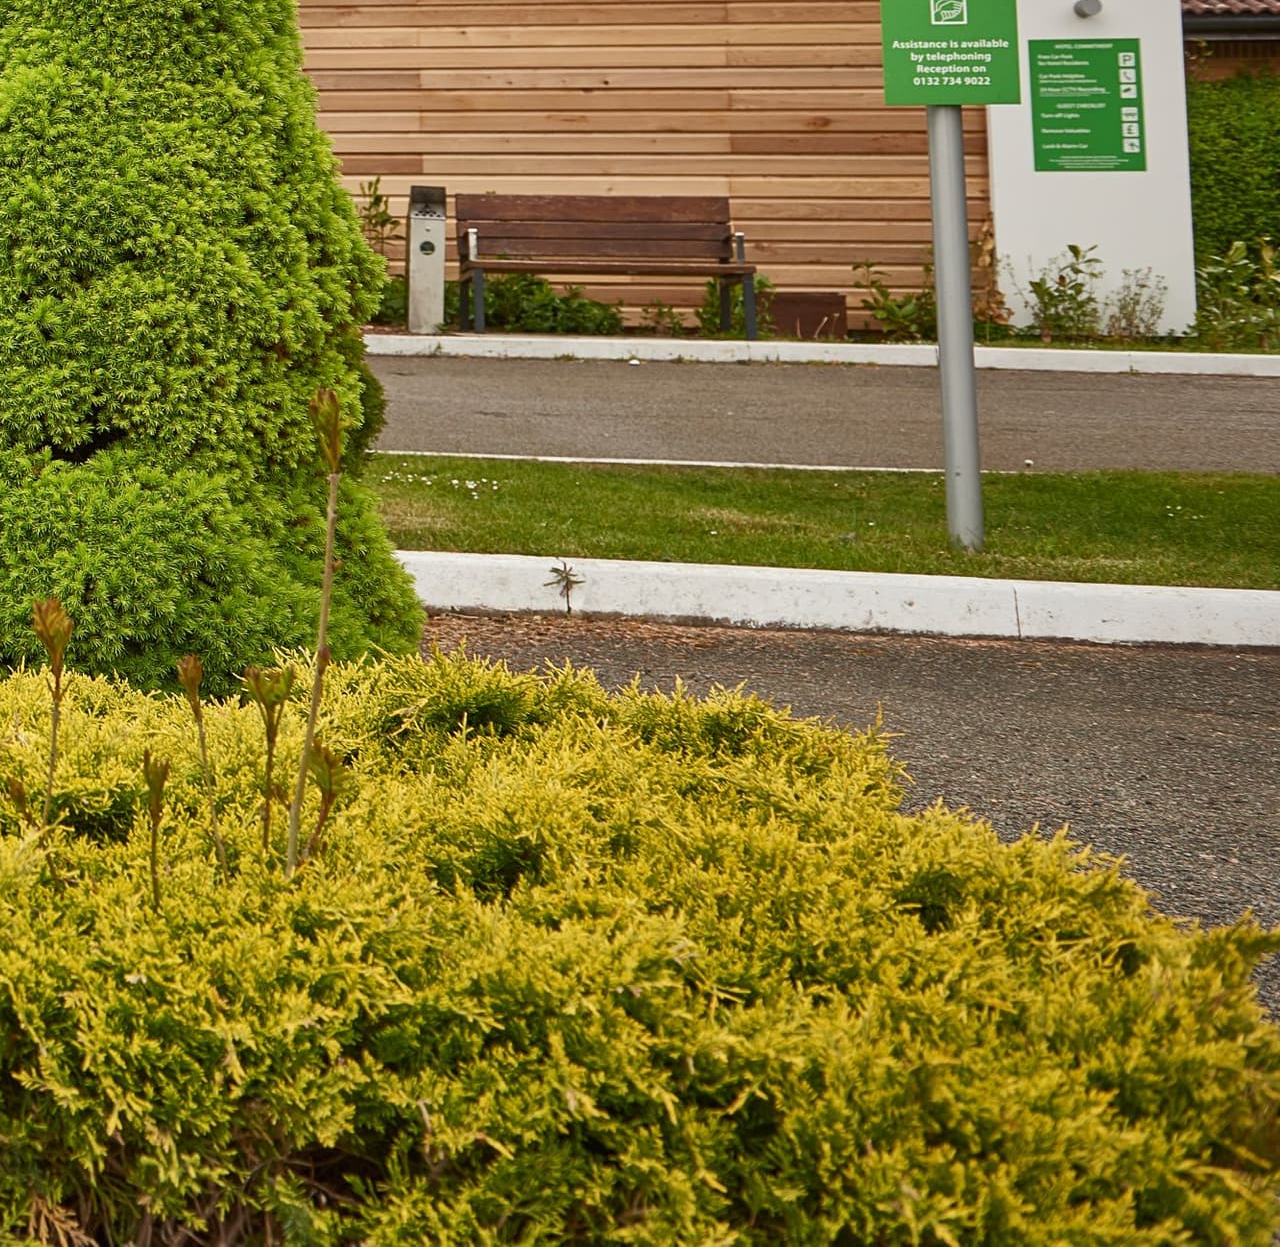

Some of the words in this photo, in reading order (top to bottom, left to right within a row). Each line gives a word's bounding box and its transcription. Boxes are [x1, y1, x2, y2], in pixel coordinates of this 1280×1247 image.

[892, 40, 948, 49] Assistance
[960, 39, 1009, 48] available
[911, 52, 924, 62] by
[926, 52, 992, 62] telephoning
[917, 65, 970, 74] Reception
[913, 77, 940, 85] 0132
[943, 77, 962, 85] 734
[964, 77, 991, 85] 9022
